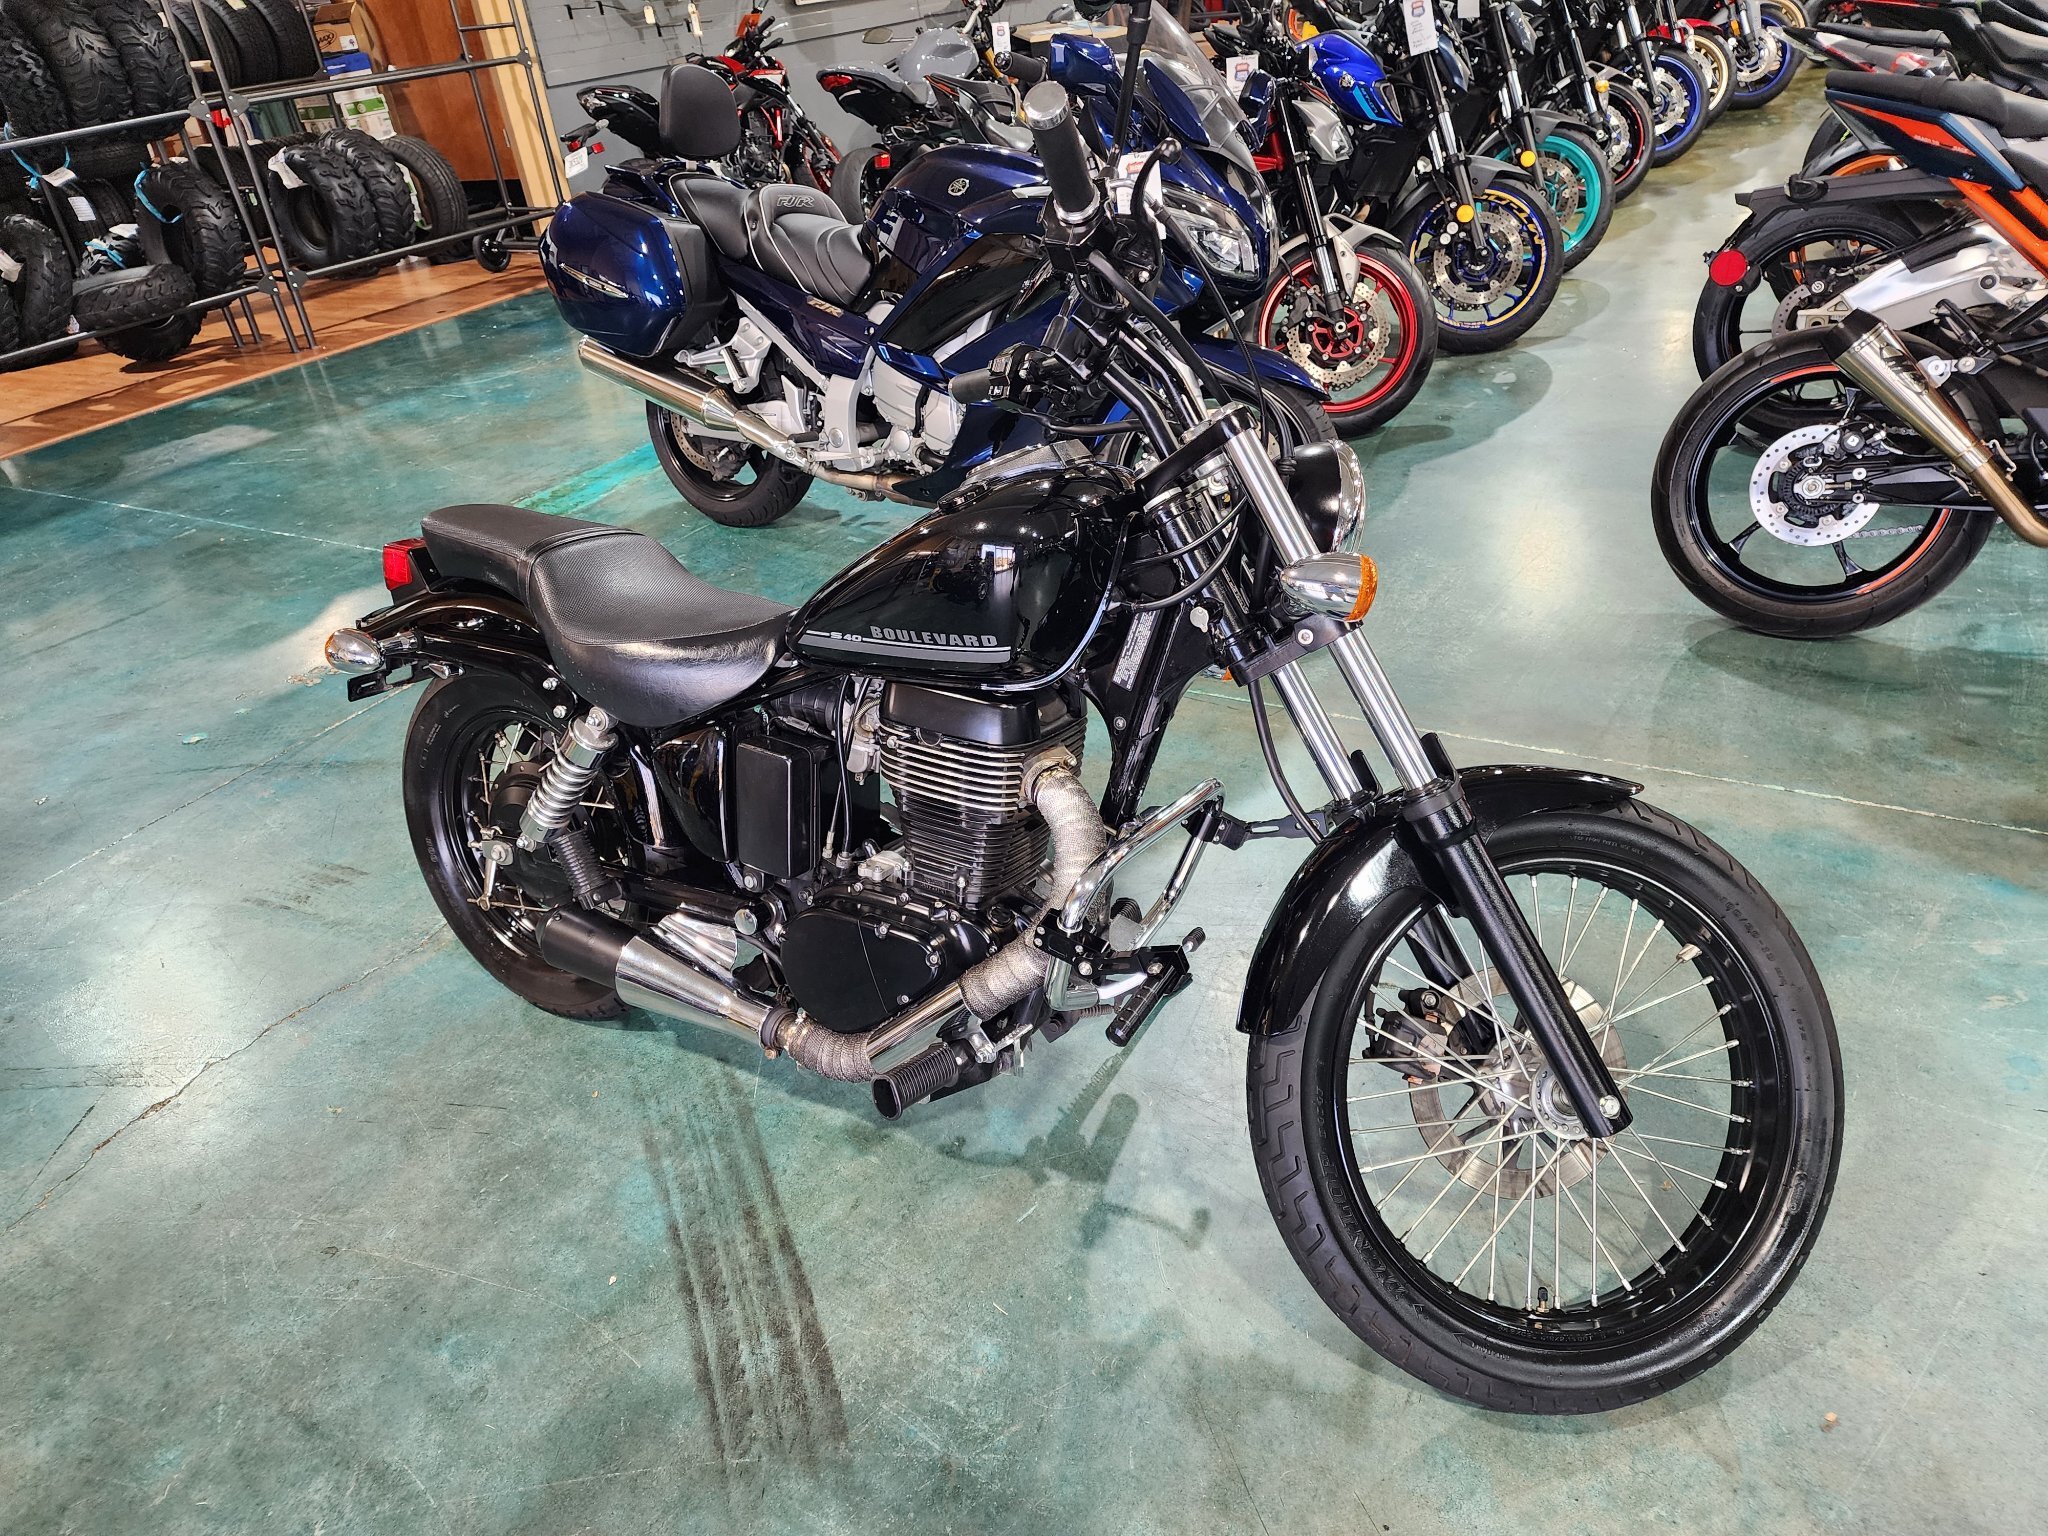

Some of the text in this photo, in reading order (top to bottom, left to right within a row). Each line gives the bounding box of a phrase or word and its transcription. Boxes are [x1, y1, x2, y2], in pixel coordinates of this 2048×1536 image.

[776, 194, 815, 208] FJR
[806, 295, 845, 318] FJR
[830, 631, 862, 642] S40
[870, 625, 998, 647] BOULEVARD
[1318, 1152, 1406, 1301] DUNLOP
